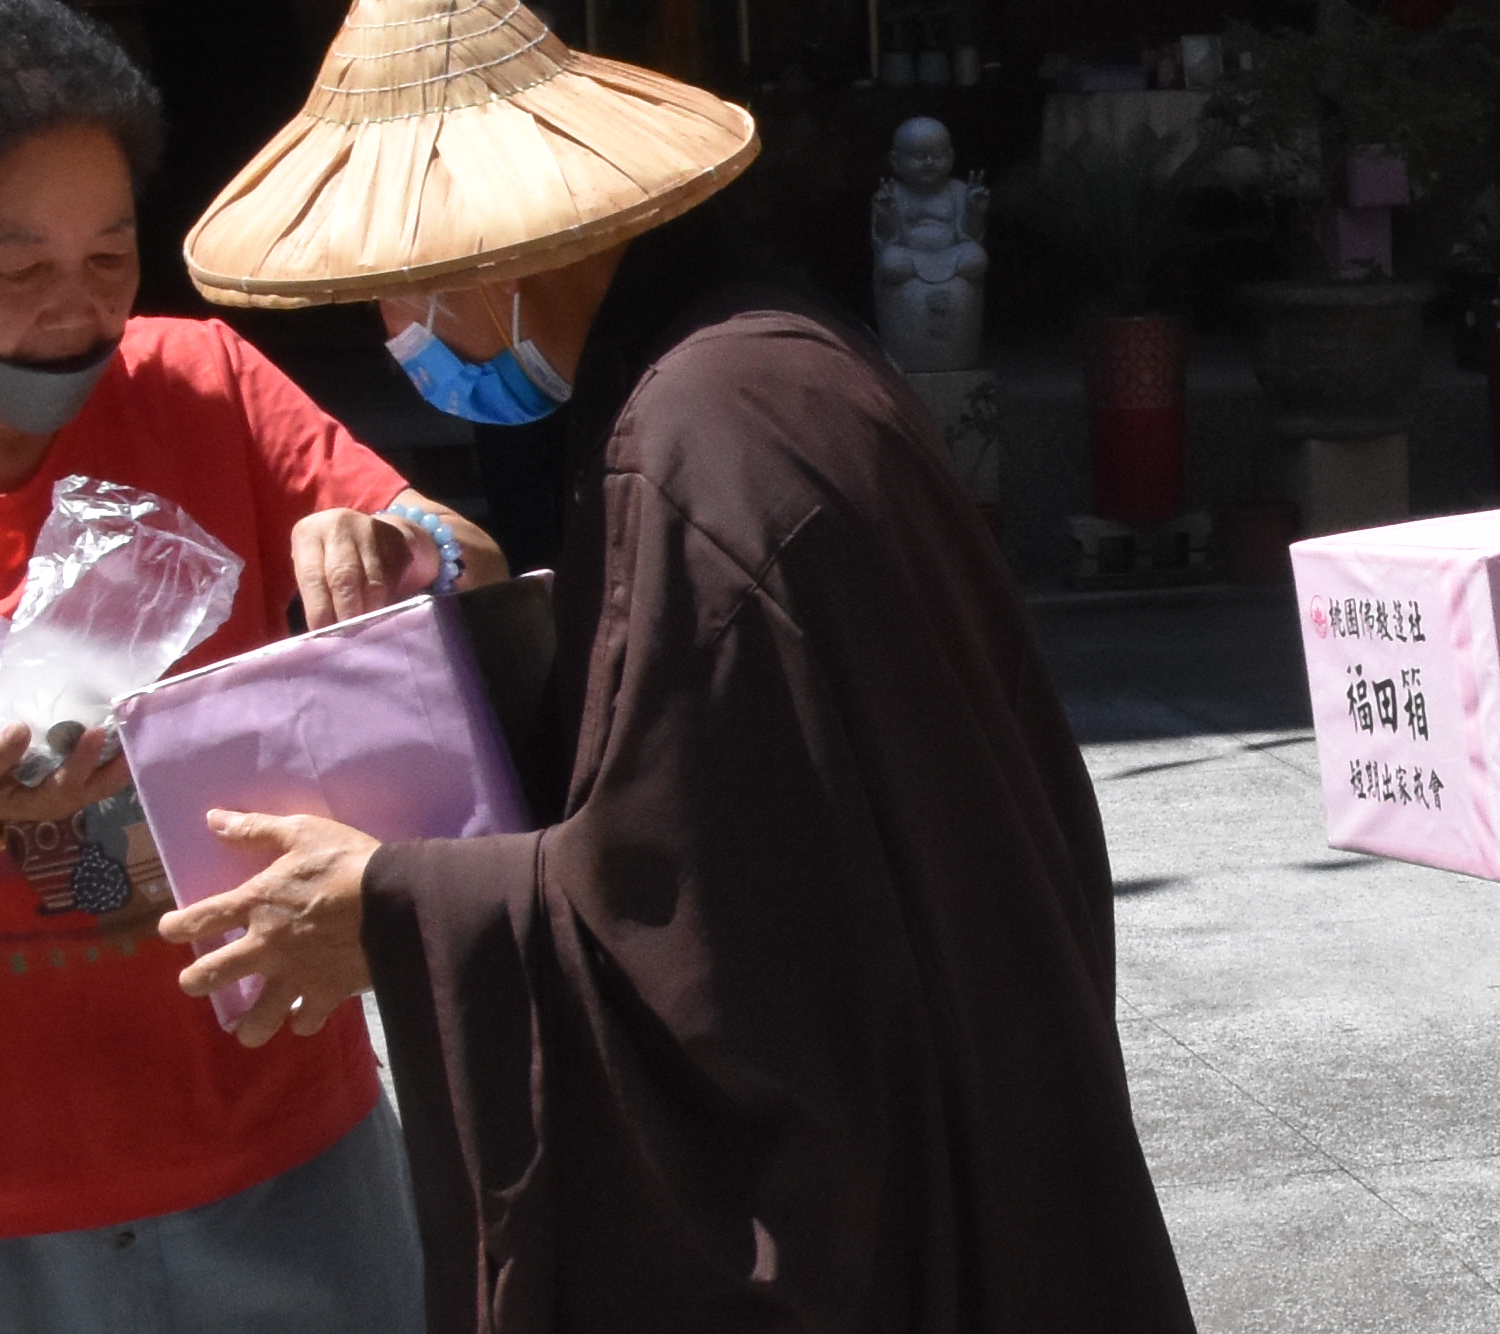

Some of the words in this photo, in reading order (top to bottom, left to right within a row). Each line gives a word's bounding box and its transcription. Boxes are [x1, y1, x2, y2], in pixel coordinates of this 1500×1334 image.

[1328, 597, 1426, 643] 桃園佛教蓮社
[1346, 663, 1429, 742] 福田箱
[1349, 758, 1445, 811] 短期出家戒會
